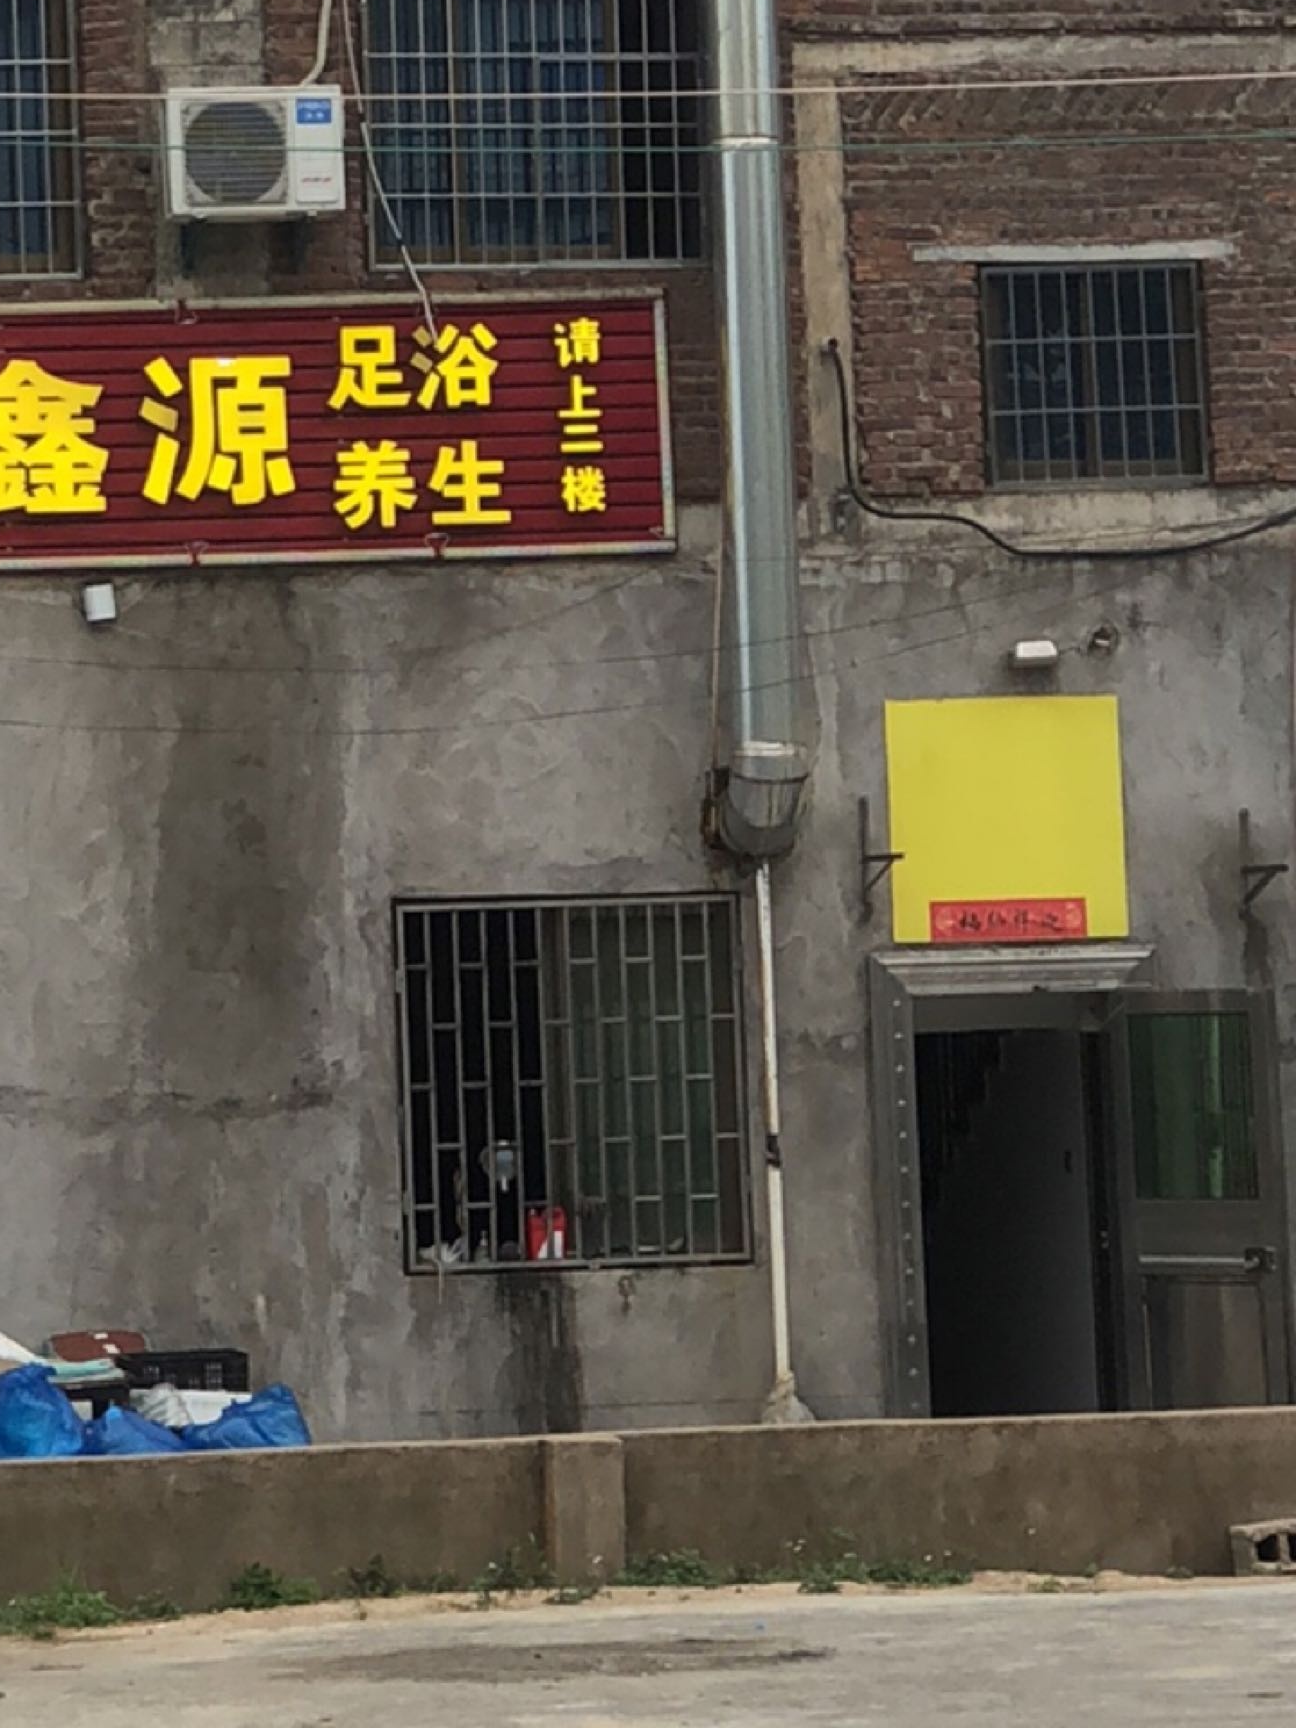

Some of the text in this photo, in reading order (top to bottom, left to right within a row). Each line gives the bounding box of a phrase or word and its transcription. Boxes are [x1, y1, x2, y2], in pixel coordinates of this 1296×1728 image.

[327, 323, 499, 410] 足浴
[554, 317, 607, 514] 请上二楼
[332, 439, 512, 531] 养生
